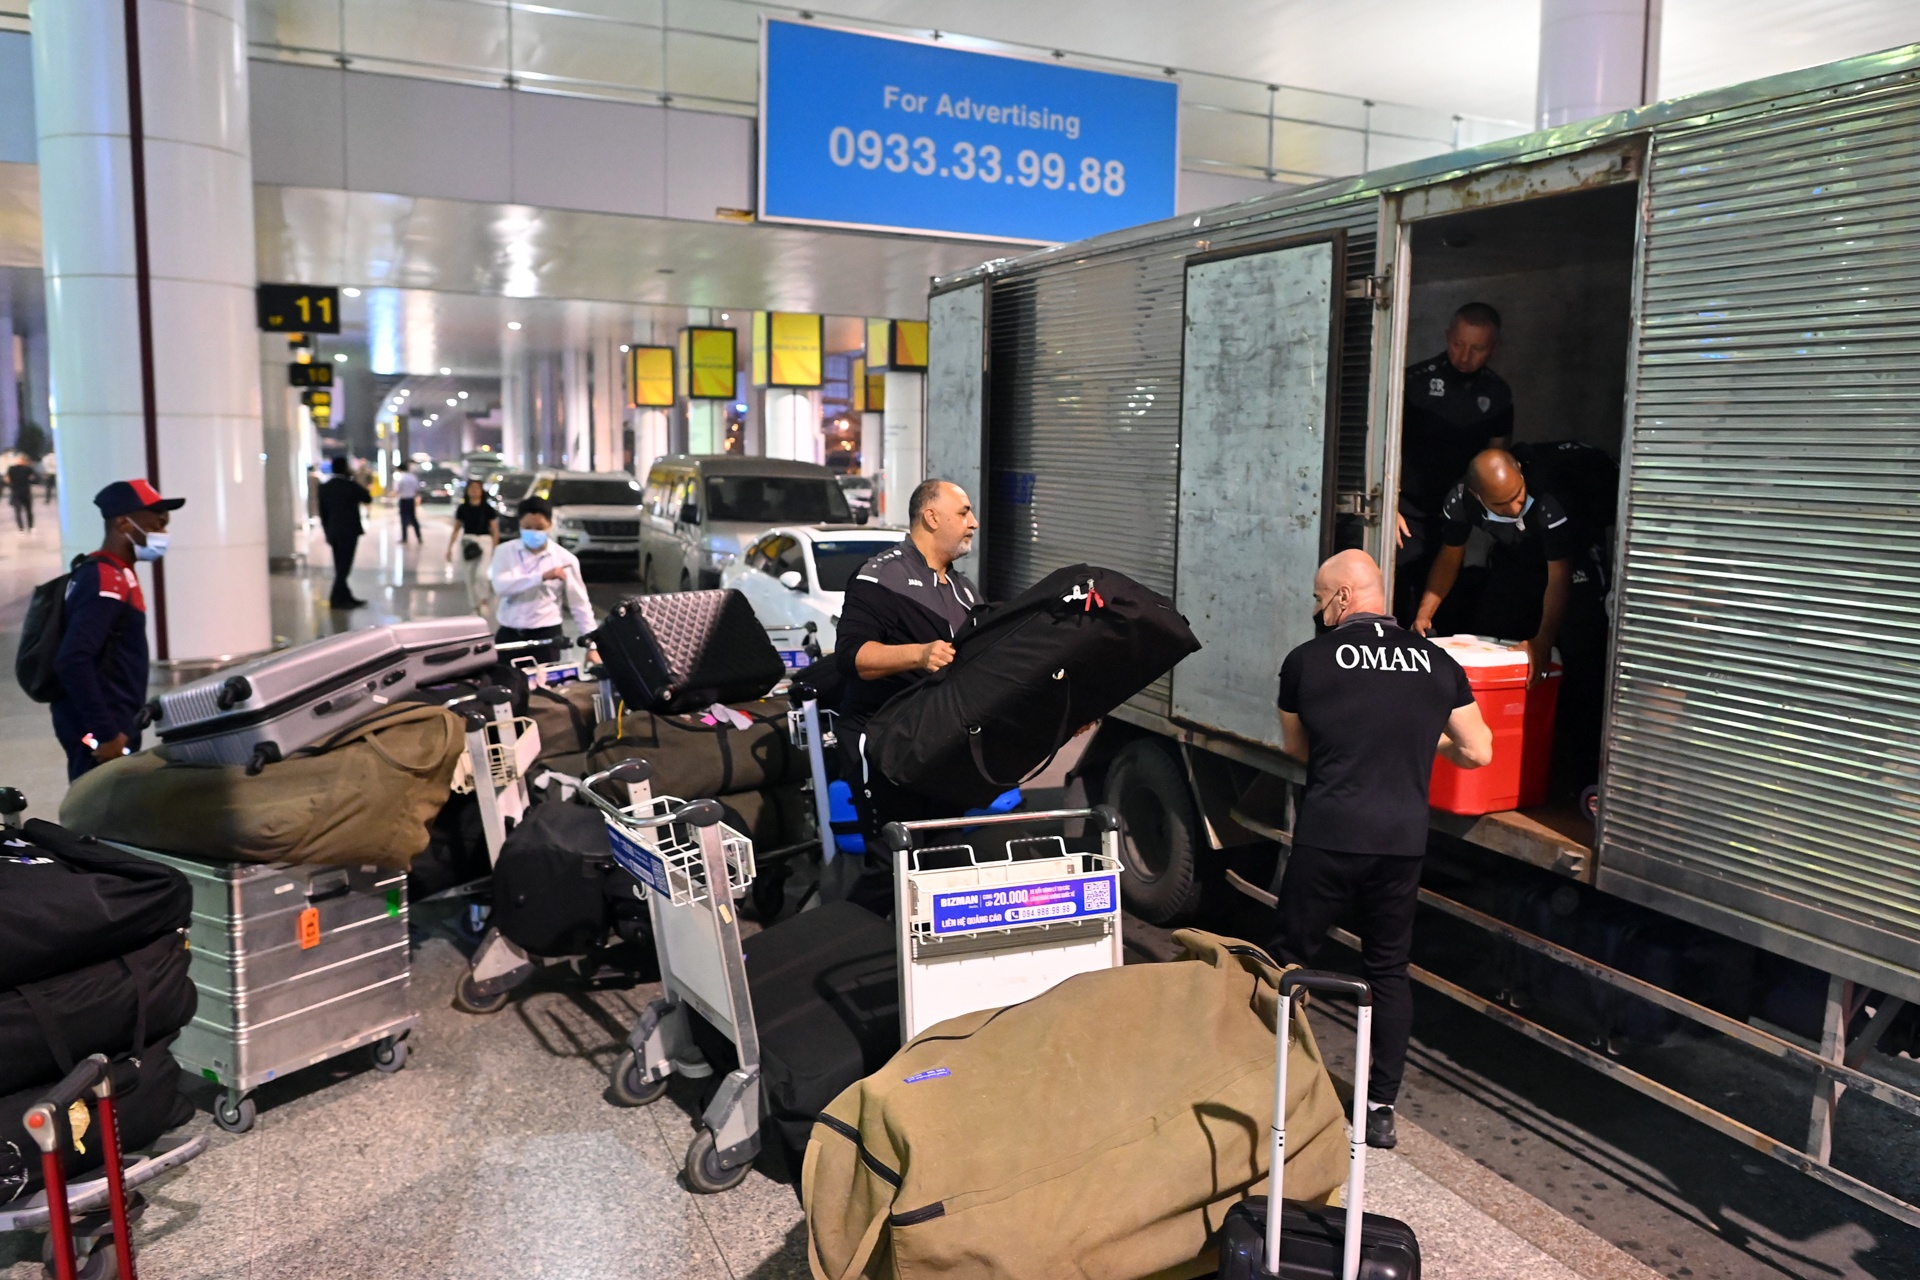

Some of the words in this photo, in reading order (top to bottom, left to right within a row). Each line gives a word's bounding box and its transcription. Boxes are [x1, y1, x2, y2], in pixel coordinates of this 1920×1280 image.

[883, 84, 928, 113] For
[935, 93, 1080, 140] Advertising
[828, 125, 1126, 197] 0933.33.99.88
[294, 295, 332, 324] 11
[1335, 643, 1432, 674] OMAN
[940, 895, 979, 907] BIZMAN
[993, 889, 1029, 906] 20.000
[941, 917, 957, 928] LIÊN
[957, 916, 967, 927] HỆ
[966, 913, 989, 925] QUẢNG
[988, 912, 1002, 923] CÁO
